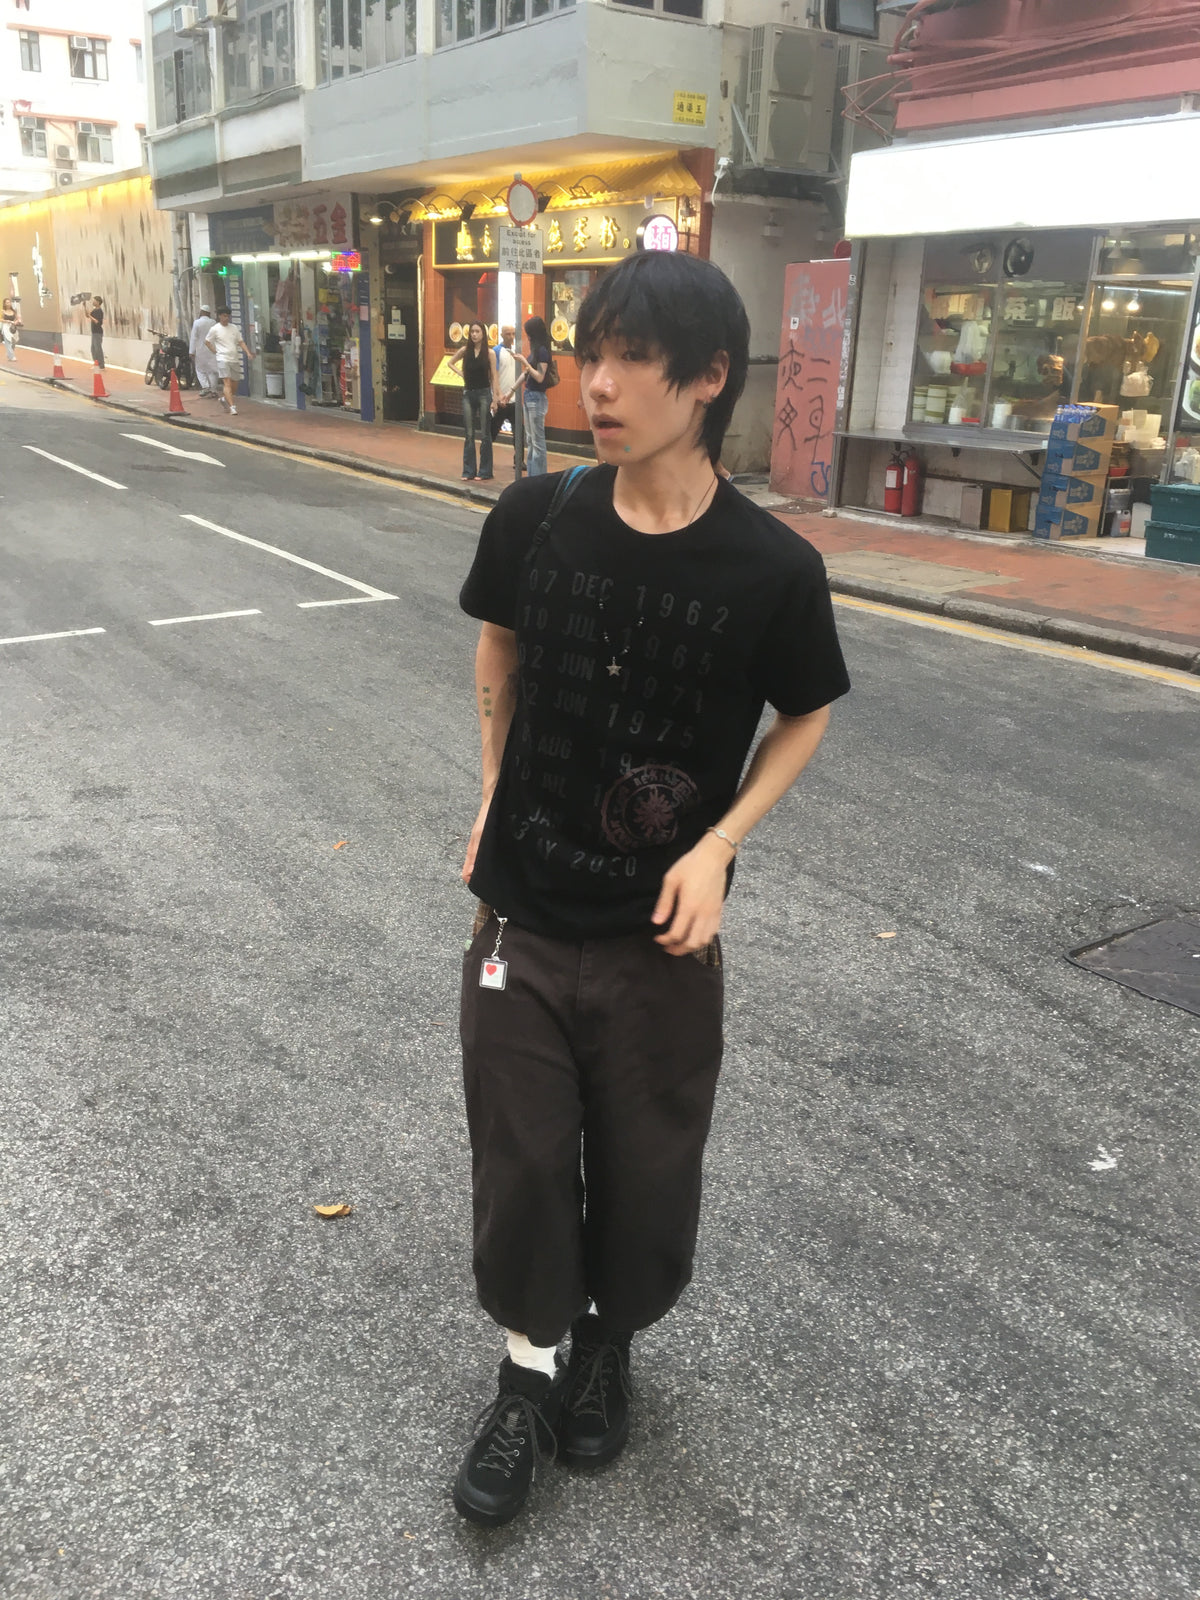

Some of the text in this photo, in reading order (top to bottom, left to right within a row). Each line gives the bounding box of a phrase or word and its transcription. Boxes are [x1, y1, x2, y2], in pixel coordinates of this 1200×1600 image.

[501, 247, 541, 258] 前往此區者
[506, 259, 537, 270] 不在此限
[529, 568, 730, 634] 07 DEC 1962
[523, 604, 549, 630] 10
[561, 612, 599, 642] JUL
[558, 652, 597, 681] JUN
[608, 703, 695, 749] 1975
